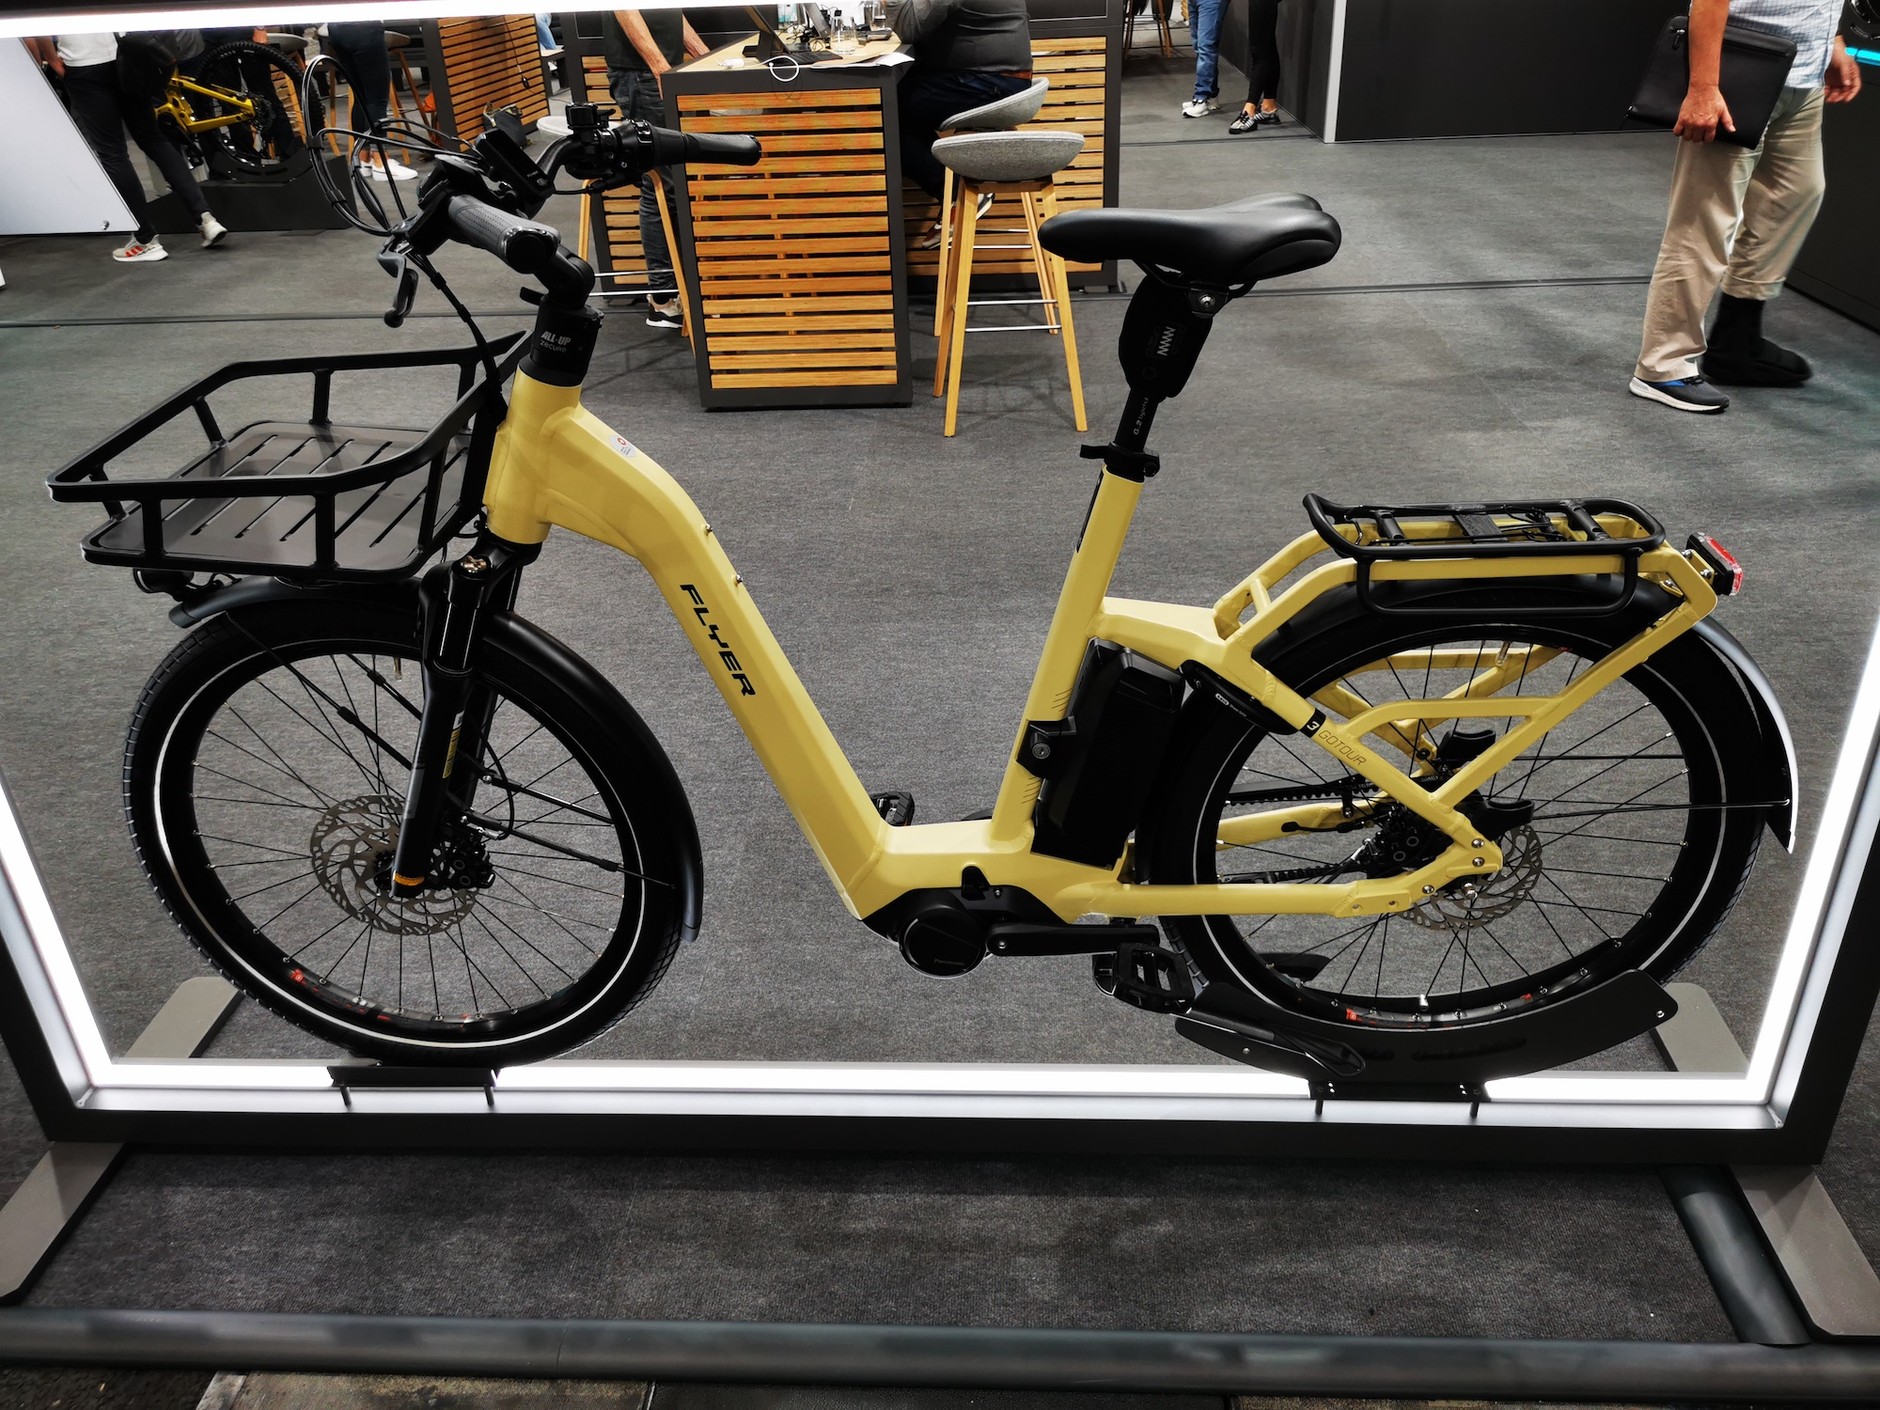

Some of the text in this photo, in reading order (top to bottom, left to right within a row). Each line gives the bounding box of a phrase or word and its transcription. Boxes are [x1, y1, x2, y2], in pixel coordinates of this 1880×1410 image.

[680, 584, 756, 696] FLYER
[1306, 721, 1367, 766] 3 GOTOUR
